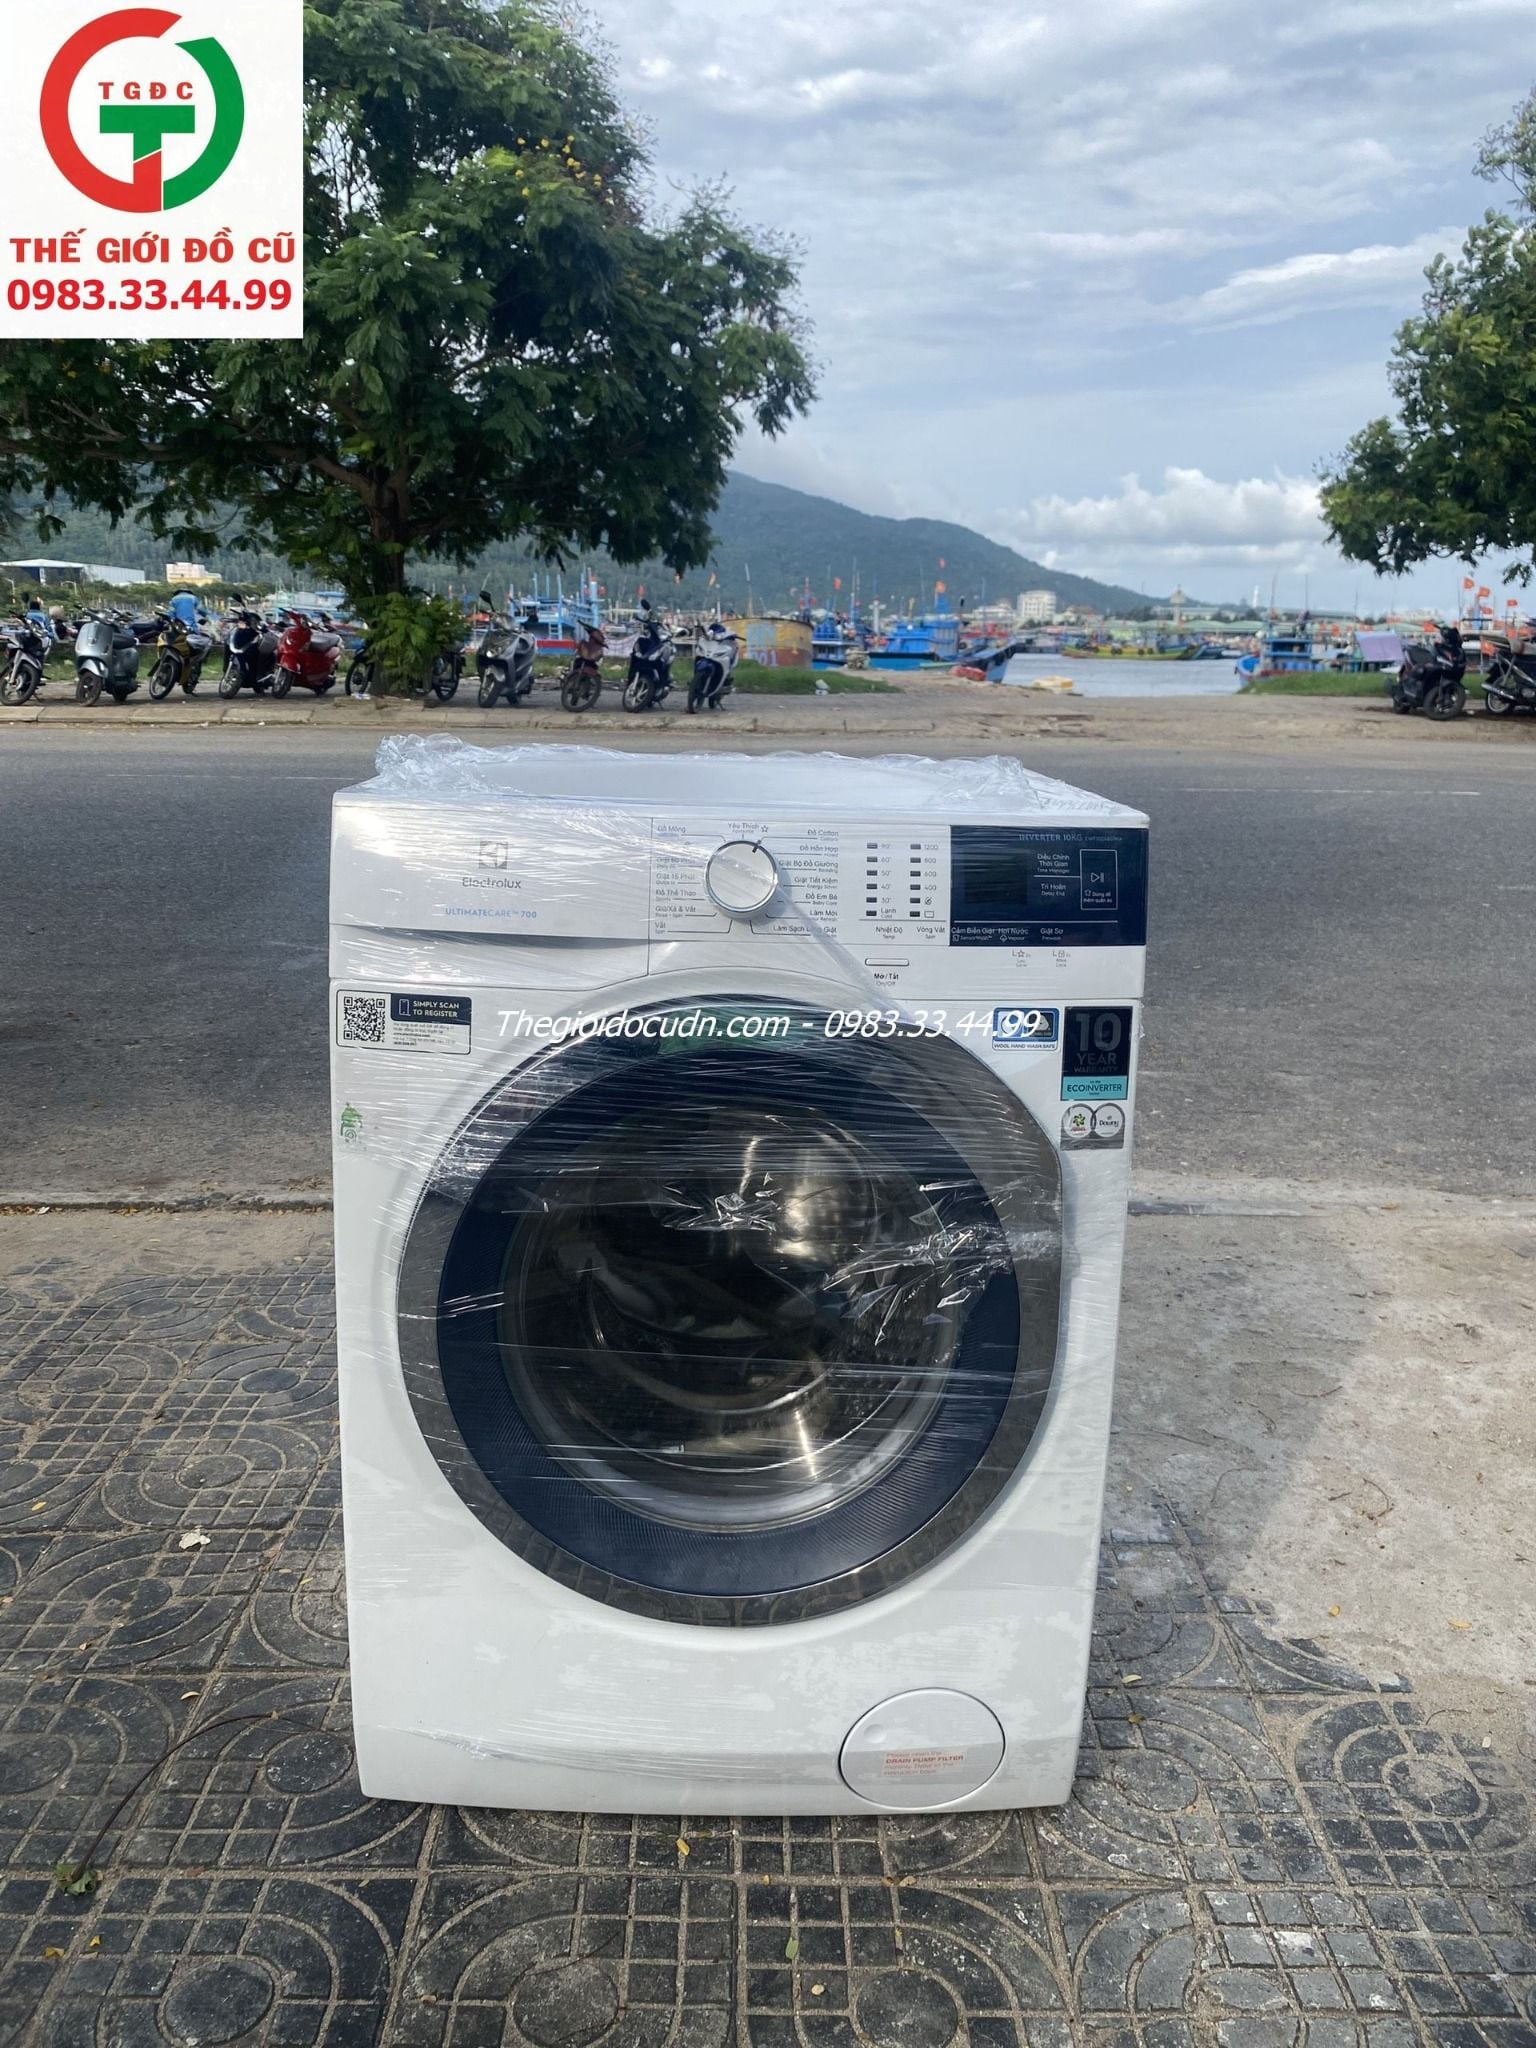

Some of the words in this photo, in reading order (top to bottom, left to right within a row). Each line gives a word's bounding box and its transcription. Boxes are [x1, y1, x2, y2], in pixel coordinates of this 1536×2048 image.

[462, 876, 521, 889] Electrolux
[520, 910, 537, 918] 700
[413, 1000, 437, 1008] SIMPLY
[439, 1001, 459, 1009] SCAN
[424, 1009, 458, 1018] REGISTER
[1075, 1012, 1122, 1052] 10
[1076, 1052, 1117, 1065] YEAR
[1067, 1084, 1122, 1092] ECOINVERTER
[1099, 1119, 1119, 1128] Downy
